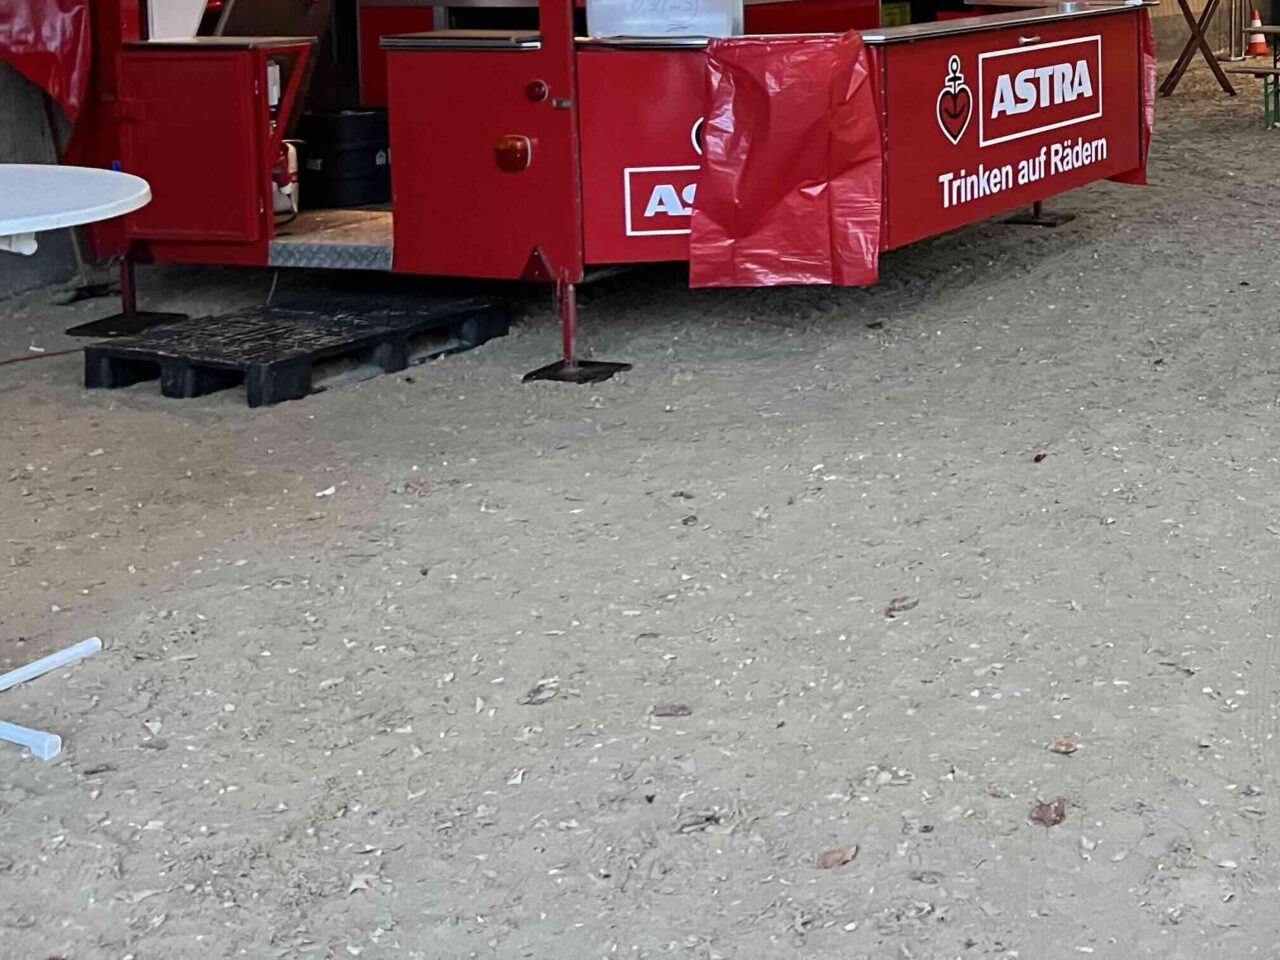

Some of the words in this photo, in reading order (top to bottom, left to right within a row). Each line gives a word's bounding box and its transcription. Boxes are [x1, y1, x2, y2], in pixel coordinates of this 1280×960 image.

[991, 59, 1093, 119] ASTRA
[939, 164, 1013, 208] Trinken
[1018, 146, 1047, 185] auf
[1050, 137, 1107, 175] Rädern
